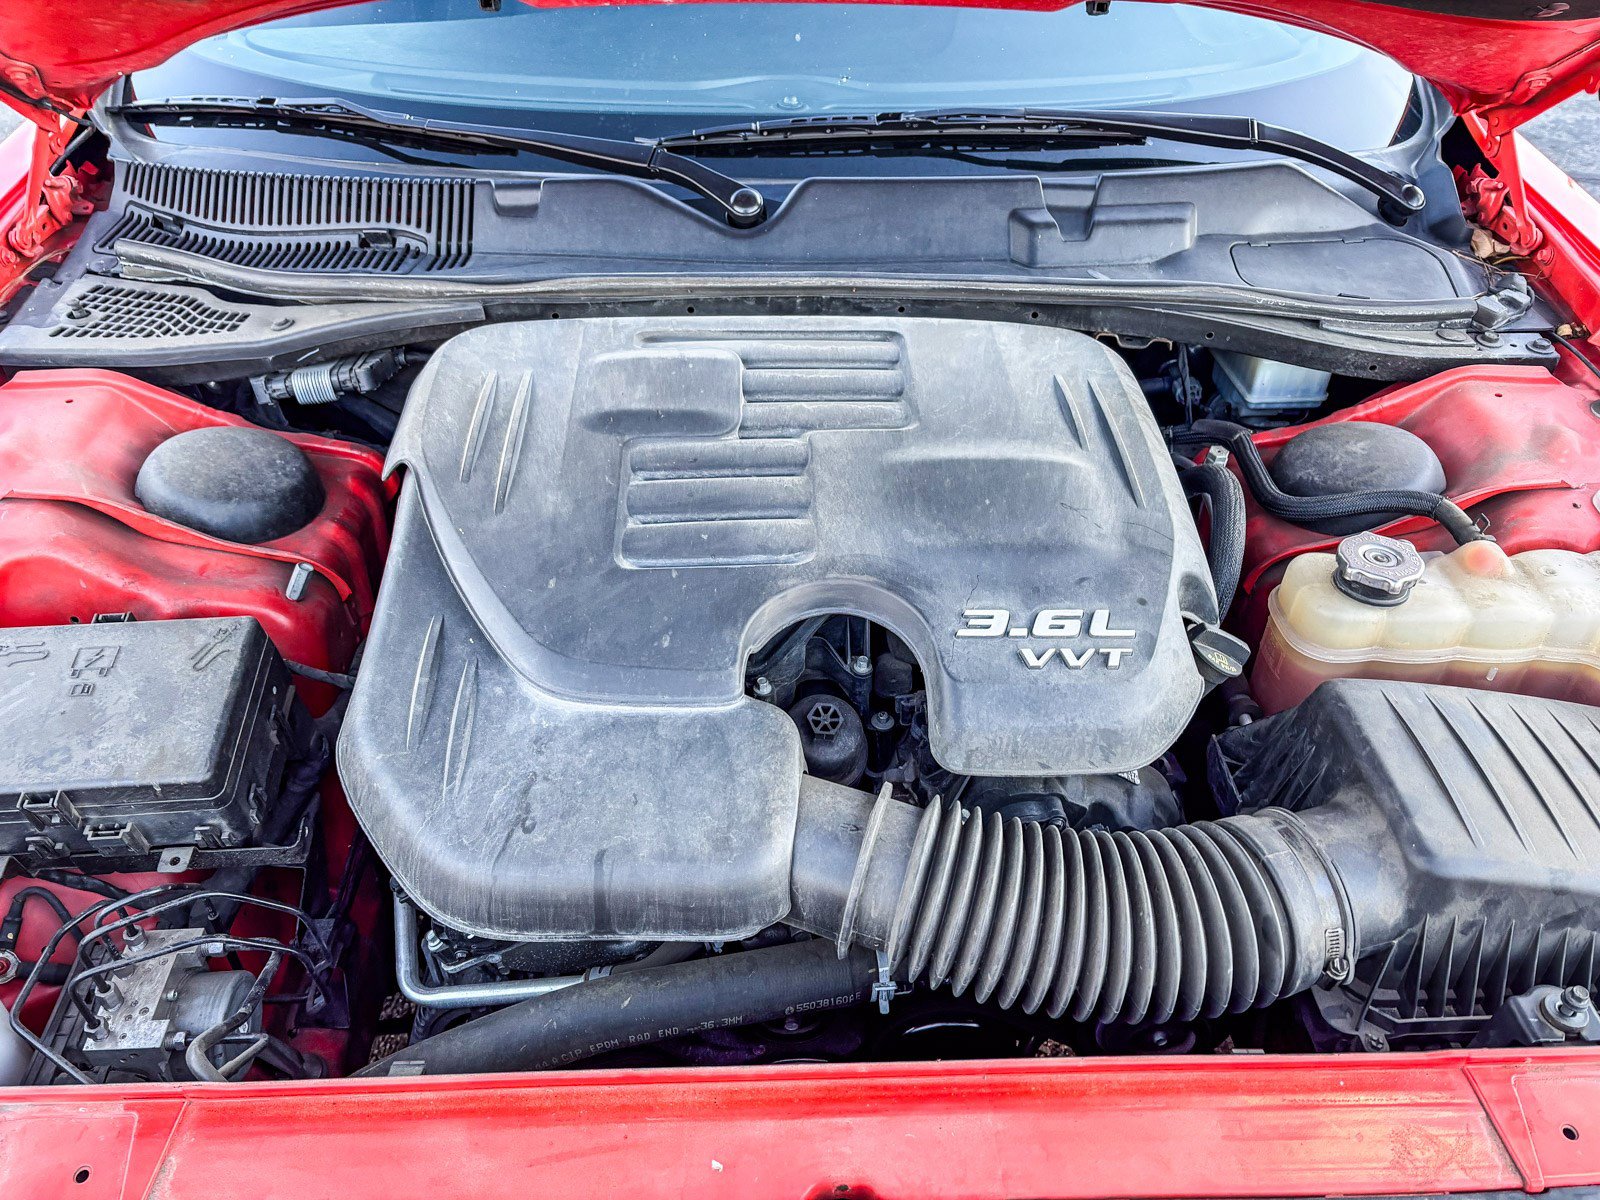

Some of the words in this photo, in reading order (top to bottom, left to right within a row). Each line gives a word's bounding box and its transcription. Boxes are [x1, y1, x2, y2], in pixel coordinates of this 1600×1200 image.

[955, 608, 1137, 638] 3.6L
[1017, 647, 1133, 670] VVT
[628, 1031, 651, 1043] RAD
[658, 1026, 680, 1037] END
